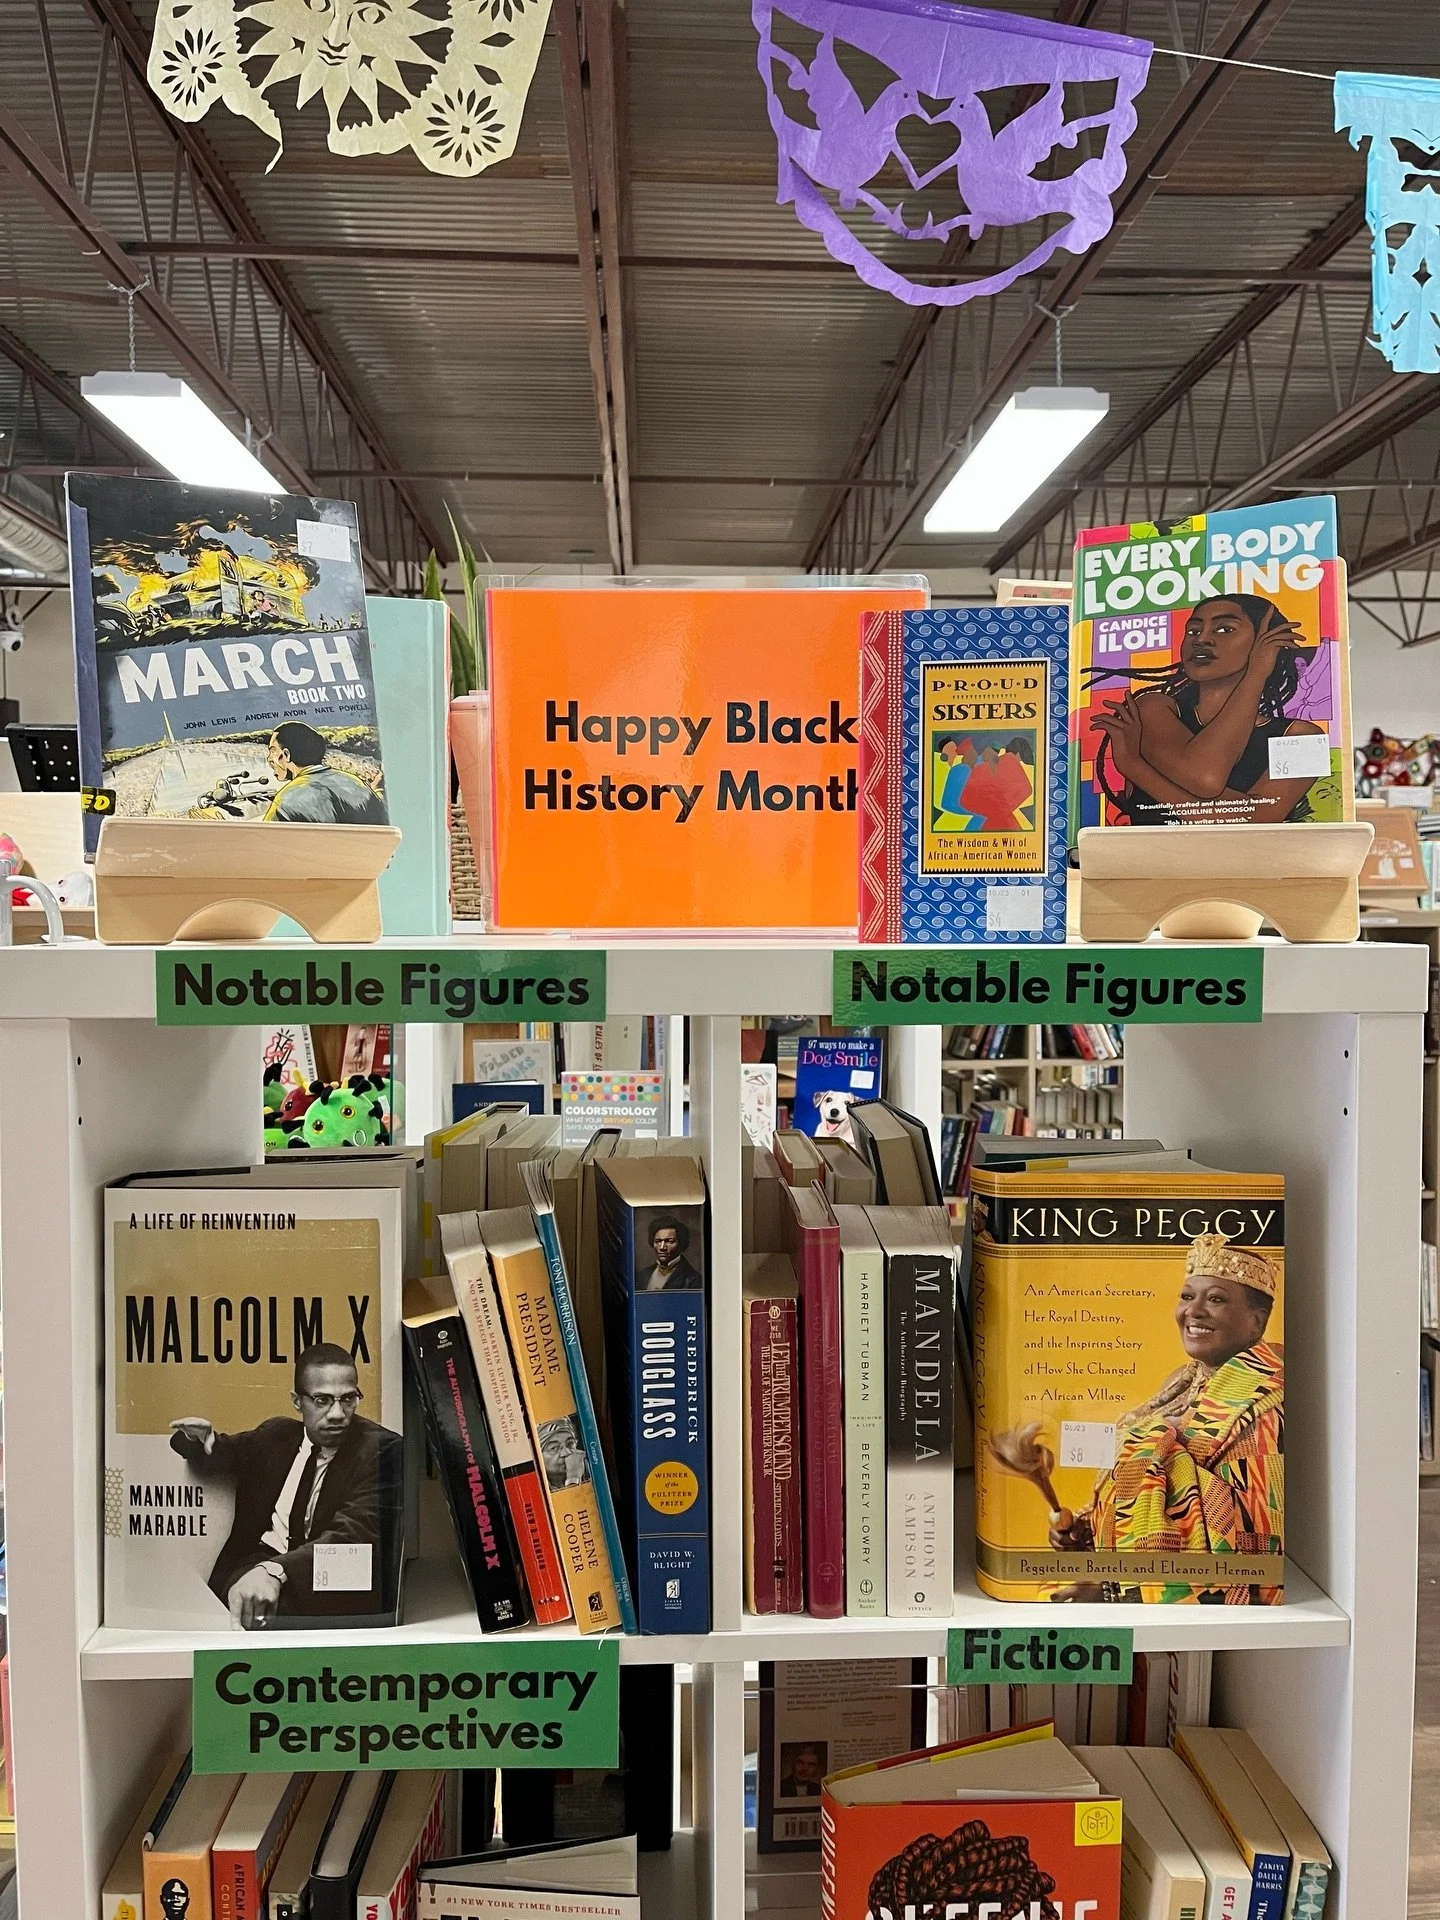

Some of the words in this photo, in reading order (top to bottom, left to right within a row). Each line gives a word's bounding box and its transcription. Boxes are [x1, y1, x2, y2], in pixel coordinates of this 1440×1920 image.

[1084, 536, 1201, 579] EVERY
[1211, 520, 1326, 563] BODY
[1084, 553, 1325, 616] LOOKING
[1099, 615, 1167, 633] CANDICE
[1099, 628, 1167, 653] ILOH
[115, 635, 361, 704] MARCH
[287, 686, 329, 705] BOOK
[332, 684, 367, 700] TWO
[183, 720, 207, 730] JOHN
[211, 716, 237, 727] LEWIS
[245, 710, 279, 722] ANDREW
[283, 708, 307, 718] AYDIN
[315, 706, 335, 715] NATE
[339, 703, 370, 713] POWELL
[932, 702, 1038, 721] SISTERS
[546, 700, 712, 756] Happy
[727, 700, 859, 744] Black
[1275, 760, 1289, 776] $6
[525, 769, 704, 823] History
[1175, 801, 1200, 809] crafted
[1214, 798, 1249, 808] ultimately
[1214, 805, 1256, 815] WOODSON
[928, 851, 1003, 861] African-American
[1006, 850, 1037, 860] Women
[937, 838, 953, 848] The
[956, 838, 989, 848] Wisdom
[992, 837, 999, 848] &
[1002, 837, 1016, 847] Wit
[1019, 837, 1027, 847] of
[174, 961, 384, 1007] Notable
[400, 963, 590, 1018] Figures
[851, 960, 1051, 1006] Notable
[1066, 962, 1248, 1018] Figures
[802, 1050, 832, 1067] Dog
[834, 1050, 878, 1067] Smile
[807, 1040, 817, 1049] 97
[819, 1042, 836, 1052] ways
[838, 1041, 846, 1050] to
[848, 1040, 868, 1050] make
[565, 1106, 657, 1116] COLORSTROLOGY
[129, 1213, 138, 1230] A
[144, 1213, 173, 1230] LIFE
[180, 1213, 196, 1230] OF
[201, 1213, 296, 1231] REINVENTION
[1011, 1208, 1119, 1240] KING
[1134, 1208, 1276, 1245] PEGGY
[551, 1255, 563, 1286] TONI
[467, 1279, 477, 1296] AND
[975, 1261, 986, 1327] KING
[1023, 1284, 1044, 1297] An
[1047, 1284, 1102, 1297] American
[1105, 1284, 1156, 1299] Secretary,
[471, 1296, 480, 1313] THE
[556, 1287, 577, 1347] MORRISON
[860, 1272, 869, 1334] HARRIET
[900, 1310, 908, 1325] The
[1024, 1309, 1046, 1323] Her
[1049, 1309, 1077, 1324] Royal
[1081, 1309, 1124, 1324] Destiny,
[126, 1295, 323, 1364] MALCOLM
[348, 1295, 371, 1364] X
[475, 1314, 488, 1346] SPEECH
[475, 1277, 484, 1294] THE
[489, 1332, 501, 1366] MARTIN
[497, 1367, 509, 1400] LUTHER
[516, 1292, 546, 1387] PRESIDENT
[534, 1295, 561, 1375] MADAME
[1024, 1336, 1044, 1348] and
[1047, 1336, 1063, 1348] the
[1066, 1336, 1113, 1350] Inspiring
[1115, 1336, 1143, 1350] Story
[446, 1357, 456, 1375] THE
[482, 1345, 493, 1367] THAT
[761, 1345, 770, 1361] THE
[900, 1331, 908, 1376] Authorized
[914, 1268, 941, 1463] MANDELA
[641, 1321, 677, 1440] DOUGLASS
[686, 1315, 698, 1443] FREDERICK
[761, 1361, 771, 1377] LIFE
[861, 1341, 870, 1401] TUBMAN
[975, 1333, 986, 1419] PEGGY
[1024, 1363, 1034, 1375] of
[1037, 1362, 1064, 1375] How
[1066, 1362, 1084, 1375] She
[1087, 1362, 1136, 1377] Changed
[489, 1367, 502, 1405] INSPIRED
[1024, 1393, 1037, 1401] an
[1040, 1388, 1084, 1401] African
[1087, 1388, 1126, 1403] Village
[762, 1388, 771, 1418] MARTIN
[772, 1374, 792, 1434] TRUMPET
[899, 1380, 908, 1422] Biography
[450, 1376, 473, 1457] AUTOBIOGRAPHY
[499, 1415, 512, 1444] NATION
[763, 1419, 772, 1448] LUTHER
[773, 1432, 792, 1481] SOUND
[1070, 1447, 1083, 1463] $8
[861, 1443, 870, 1509] BEVERLY
[129, 1484, 204, 1508] MANNING
[466, 1465, 497, 1553] MALCOLM
[129, 1515, 208, 1537] MARABLE
[577, 1509, 599, 1569] HELENE
[861, 1516, 870, 1564] LOWRY
[904, 1492, 917, 1579] SAMPSON
[923, 1491, 936, 1582] ANTHONY
[563, 1513, 584, 1574] COOPER
[650, 1551, 680, 1559] DAVID
[684, 1550, 695, 1558] W.
[485, 1552, 501, 1571] X
[653, 1561, 692, 1569] BLIGHT
[1020, 1559, 1081, 1576] Peggielene
[1086, 1559, 1128, 1574] Bartels
[1132, 1561, 1155, 1574] and
[1161, 1559, 1210, 1575] Eleanor
[1215, 1559, 1266, 1576] Herman
[964, 1629, 1121, 1671] Fiction
[216, 1662, 598, 1714] Contemporary
[249, 1708, 564, 1764] Perspectives
[1257, 1872, 1283, 1881] DALILA
[1259, 1862, 1285, 1872] ZAKIYA
[234, 1863, 246, 1911] AFRICAN
[1223, 1886, 1236, 1910] GET
[1256, 1881, 1282, 1891] HARRIS
[461, 1898, 485, 1907] NEW
[488, 1900, 515, 1909] YORK
[518, 1902, 551, 1911] TIMES
[555, 1905, 621, 1916] BESTSELLER
